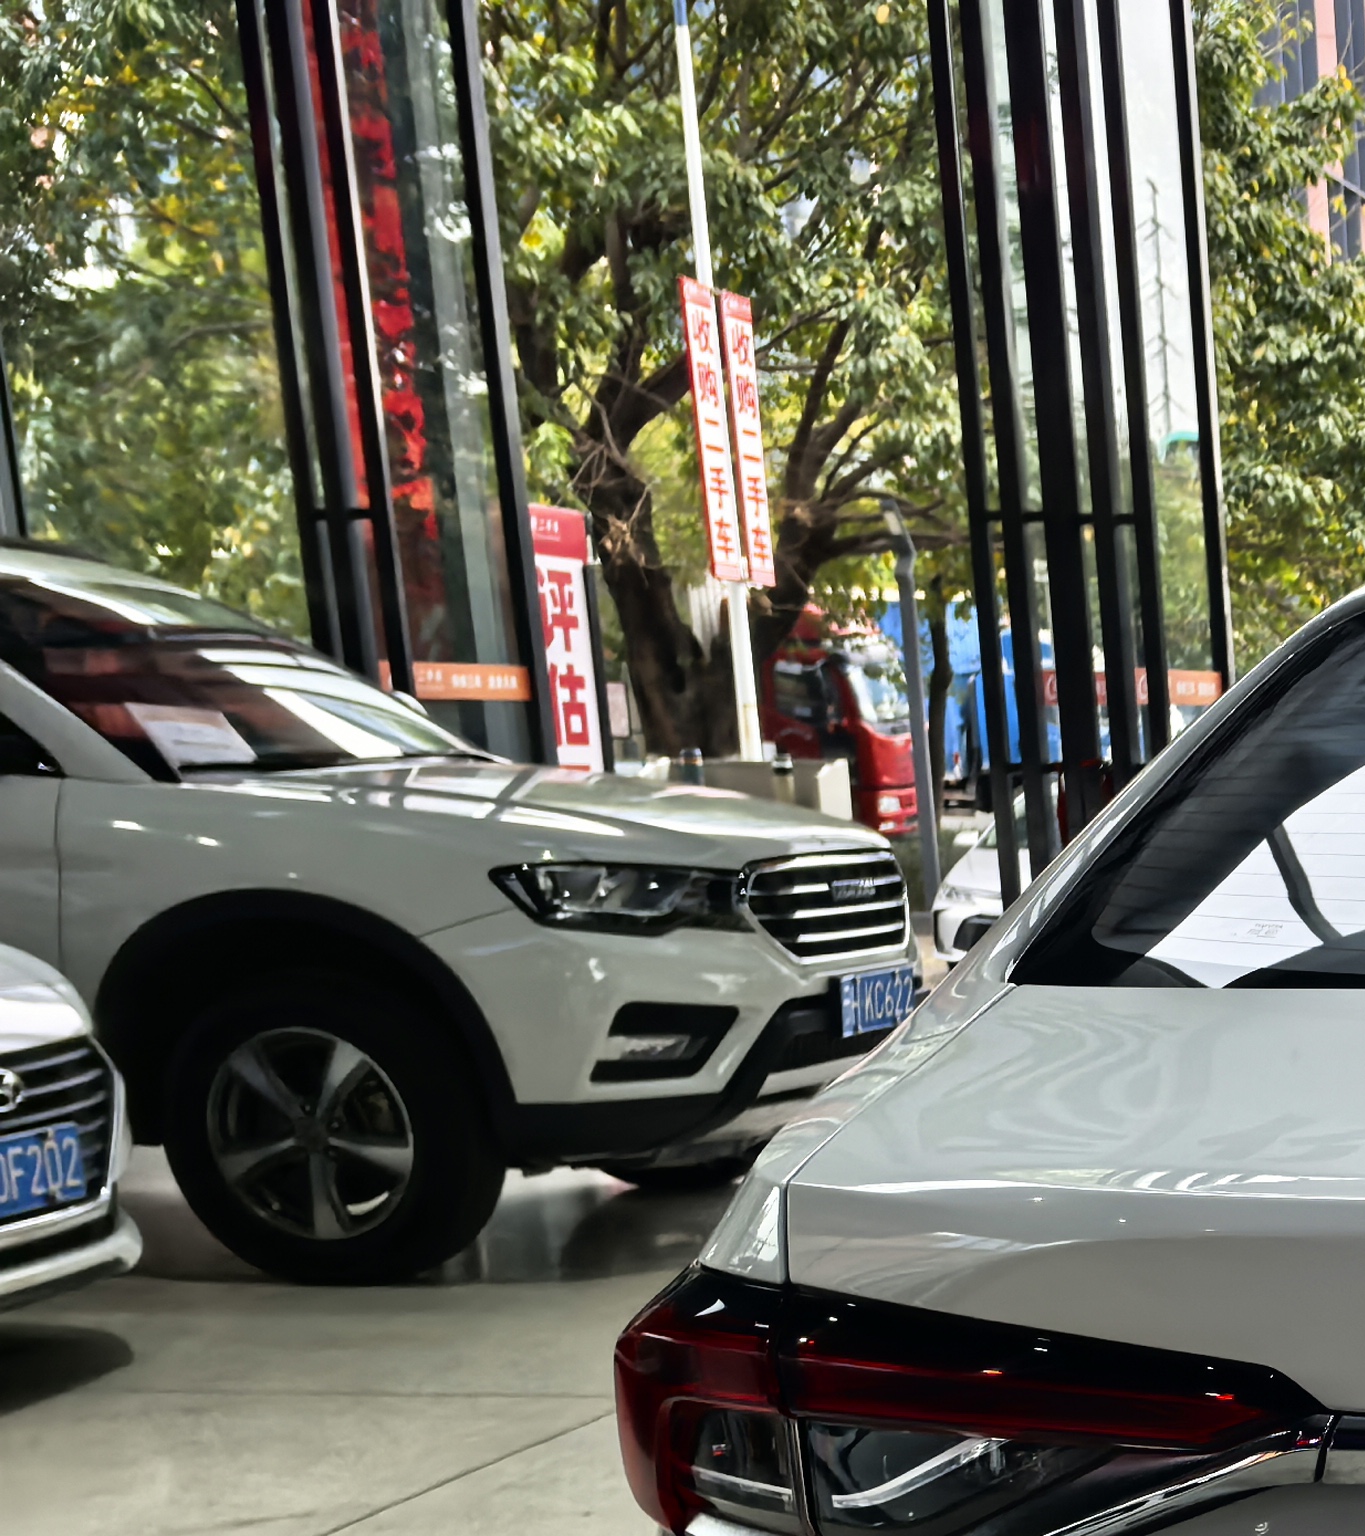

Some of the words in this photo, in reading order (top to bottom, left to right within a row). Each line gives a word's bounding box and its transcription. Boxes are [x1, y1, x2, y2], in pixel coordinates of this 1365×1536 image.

[692, 309, 735, 560] 收购二手车
[731, 324, 769, 567] 收购二手车
[536, 566, 593, 772] 评估
